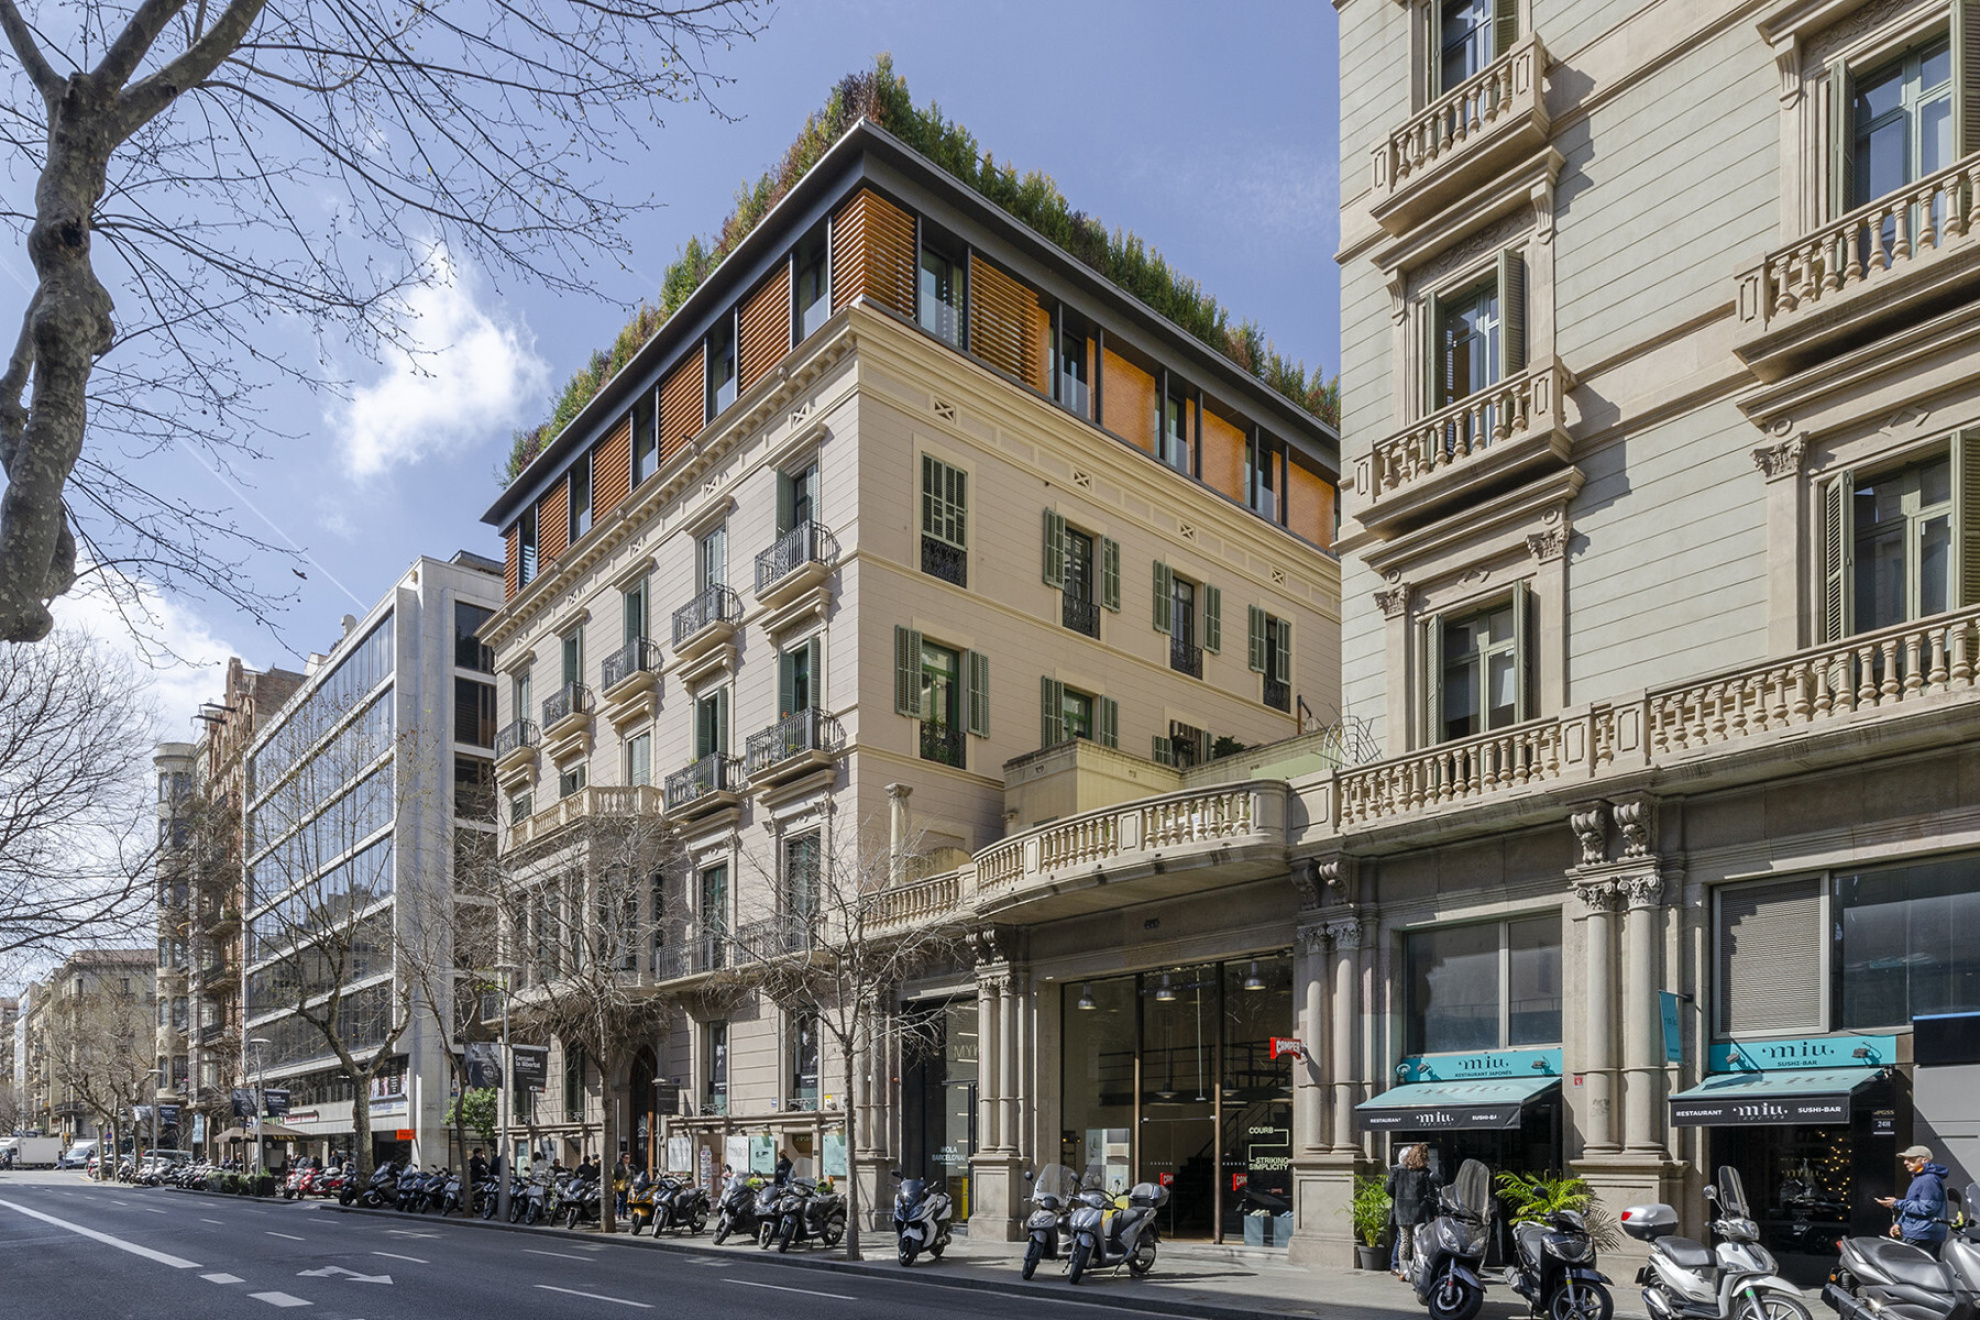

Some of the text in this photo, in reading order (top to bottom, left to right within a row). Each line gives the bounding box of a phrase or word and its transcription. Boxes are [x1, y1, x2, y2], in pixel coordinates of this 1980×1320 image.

[1276, 1040, 1300, 1053] CAMPER
[1676, 1109, 1722, 1117] RESTAURANT
[1248, 1126, 1274, 1134] COURB
[1255, 1156, 1289, 1164] STRIKING
